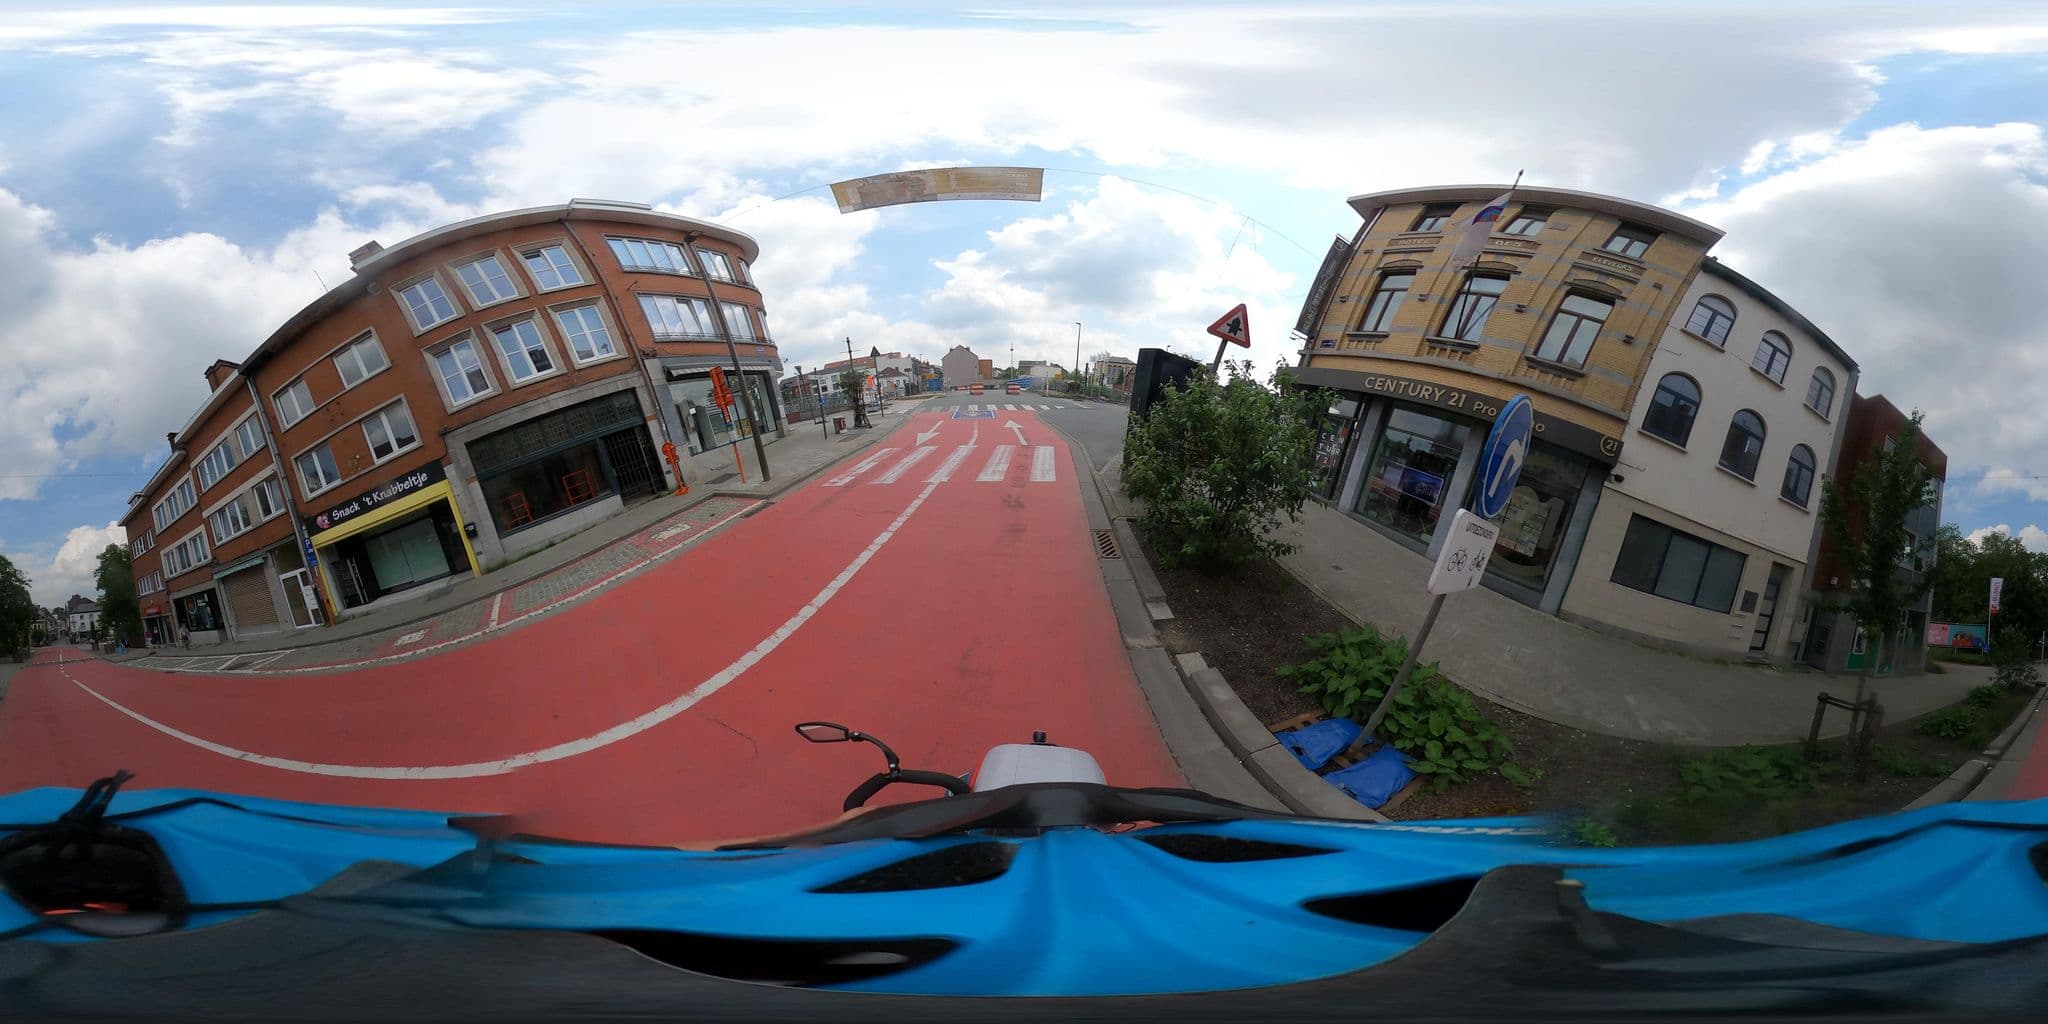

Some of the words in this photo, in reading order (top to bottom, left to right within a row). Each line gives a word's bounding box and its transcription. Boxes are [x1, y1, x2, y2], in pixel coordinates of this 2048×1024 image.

[1364, 376, 1446, 401] CENTURY
[1448, 392, 1466, 408] 21
[1473, 401, 1497, 416] Pro
[1605, 439, 1617, 452] 21
[332, 502, 360, 520] Snack
[372, 472, 428, 503] Knabbeltje
